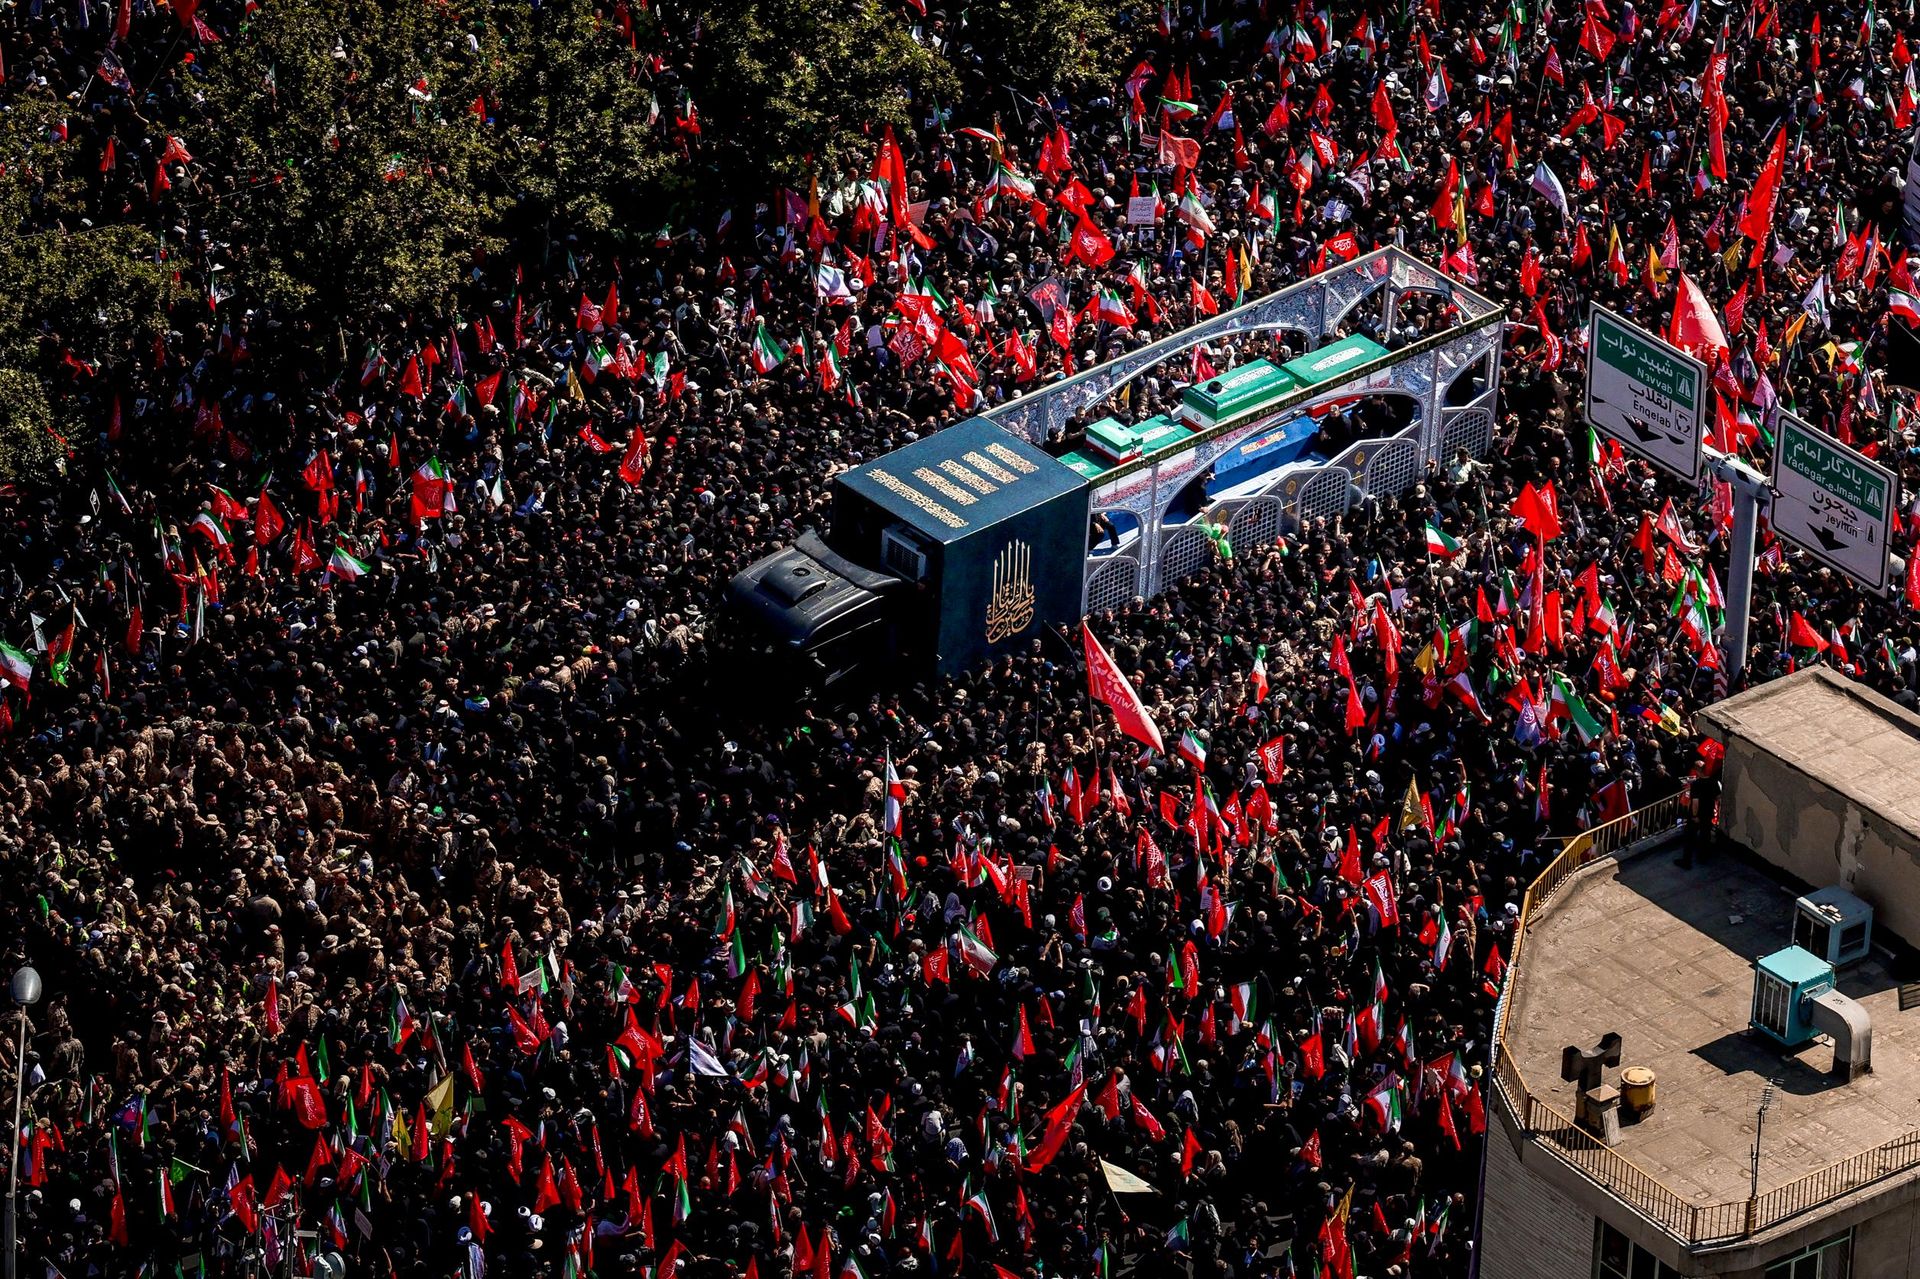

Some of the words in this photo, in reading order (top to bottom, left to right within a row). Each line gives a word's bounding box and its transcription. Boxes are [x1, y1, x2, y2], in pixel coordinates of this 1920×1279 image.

[1602, 333, 1636, 358] نواب
[1640, 352, 1673, 377] شهید
[1628, 384, 1672, 413] انقلاب
[1633, 400, 1671, 428] Enqelab
[1794, 440, 1821, 463] امام
[1821, 457, 1862, 491] یادگار
[1813, 490, 1858, 523] جیحون
[1826, 513, 1857, 538] Jeyhun
